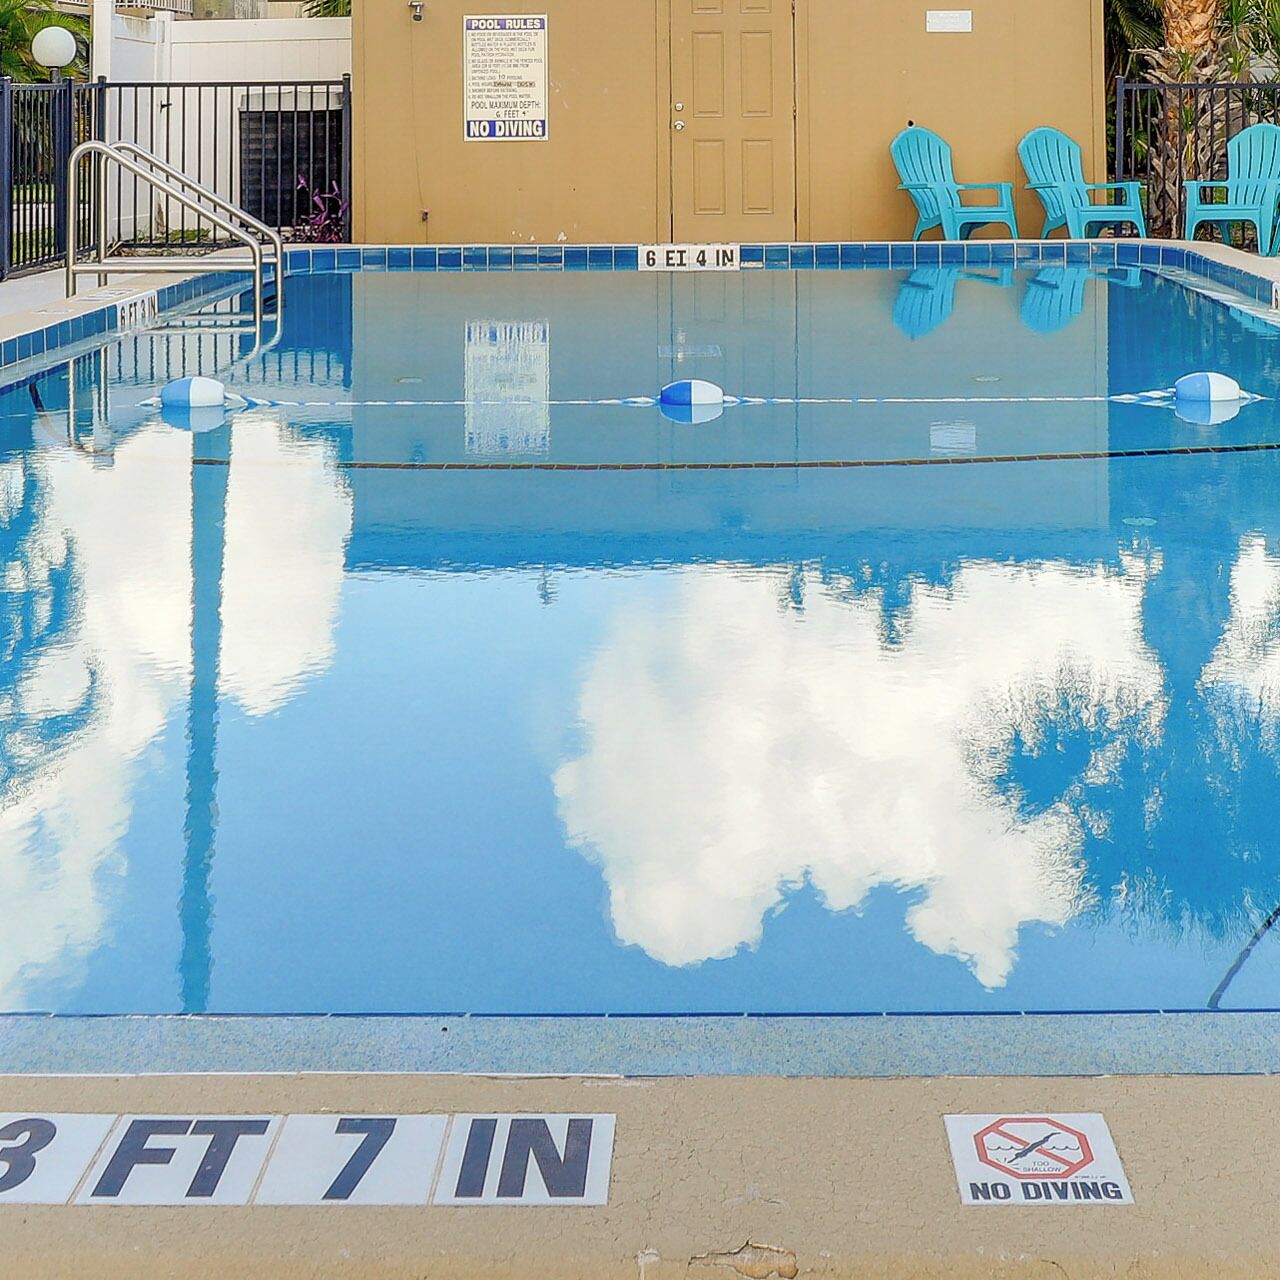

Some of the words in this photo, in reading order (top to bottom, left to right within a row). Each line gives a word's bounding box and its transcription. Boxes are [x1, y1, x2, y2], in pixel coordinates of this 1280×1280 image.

[471, 19, 501, 30] POOL
[505, 19, 541, 29] RULES
[471, 101, 488, 109] POOL
[489, 101, 518, 109] MAXIMUM
[504, 110, 520, 118] FEET
[470, 121, 490, 137] NO
[495, 121, 543, 137] DIVING
[646, 250, 656, 267] 6
[696, 250, 707, 267] 4
[716, 249, 734, 267] IN
[1274, 288, 1279, 309] 6
[120, 305, 126, 326] 6
[129, 302, 138, 325] FT
[140, 299, 146, 319] 3
[147, 295, 156, 320] IN
[90, 1119, 271, 1198] FT
[320, 1118, 399, 1201] 7
[453, 1118, 596, 1199] IN
[970, 1182, 1011, 1201] NO
[1020, 1181, 1124, 1200] DIVING
